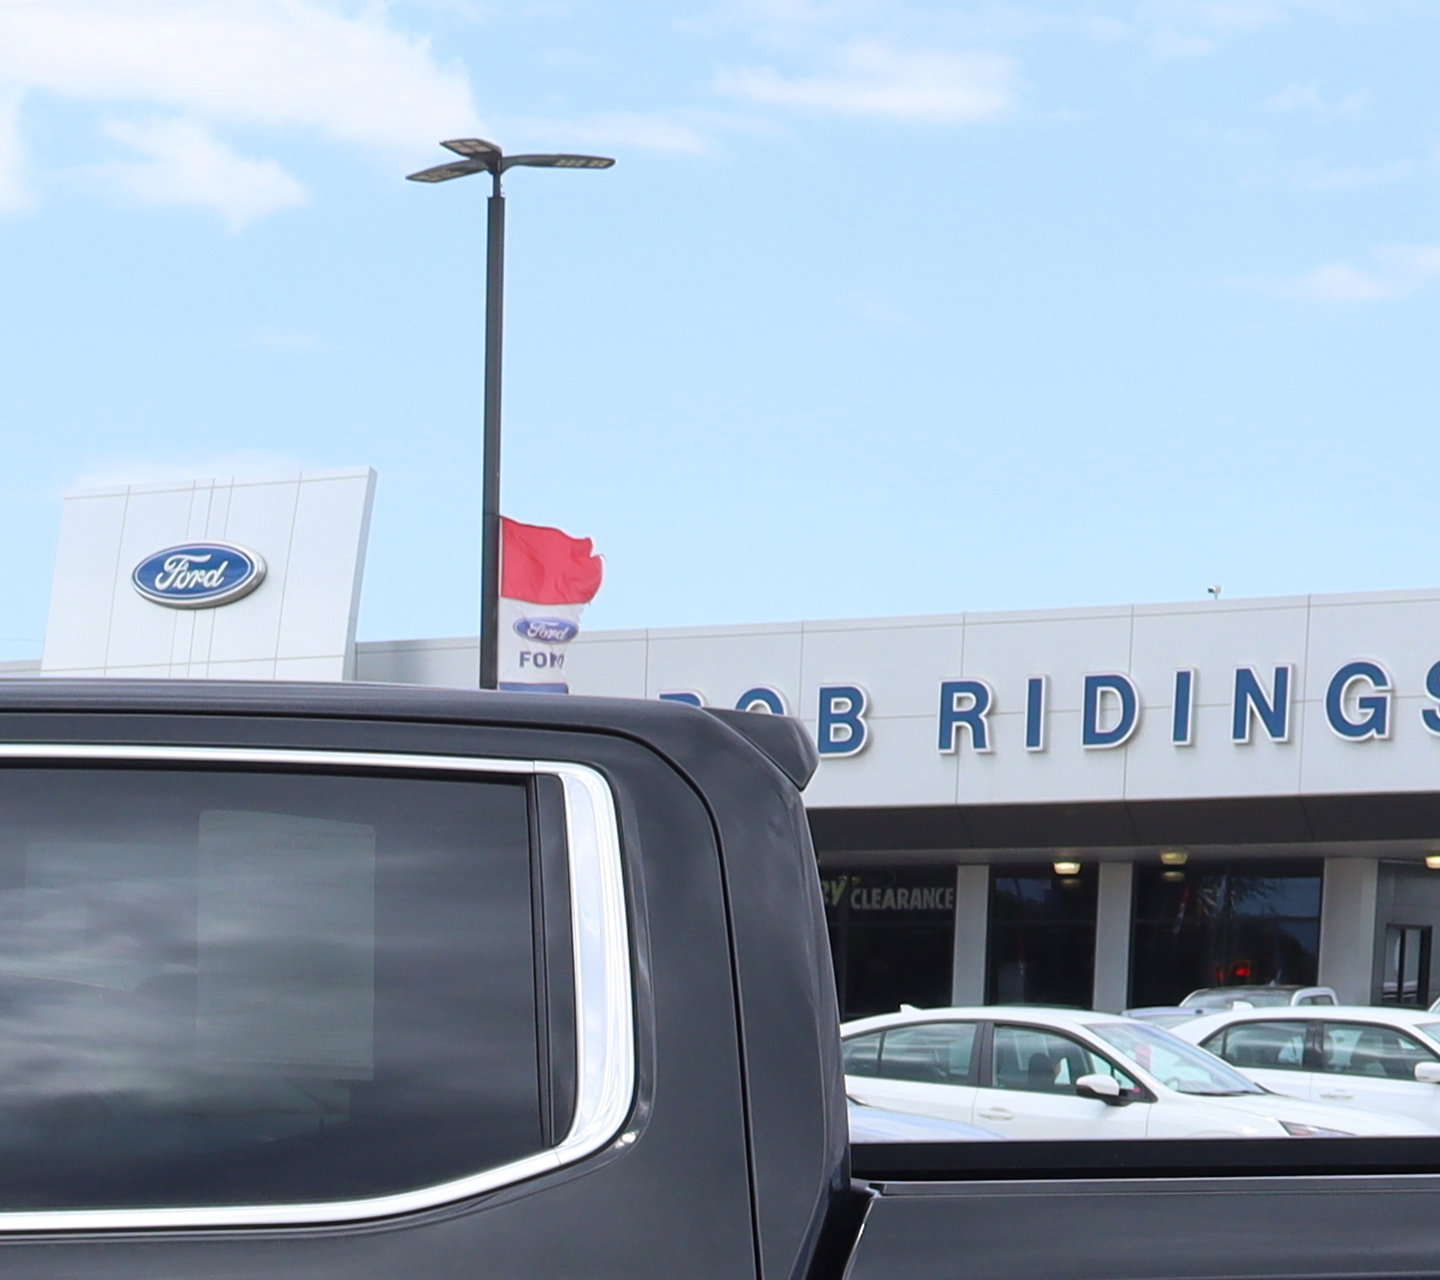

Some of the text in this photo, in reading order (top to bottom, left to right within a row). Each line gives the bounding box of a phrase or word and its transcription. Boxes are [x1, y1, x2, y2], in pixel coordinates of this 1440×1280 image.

[154, 554, 229, 590] Ford
[527, 621, 570, 641] Ford
[850, 887, 954, 910] CLEARANCE
